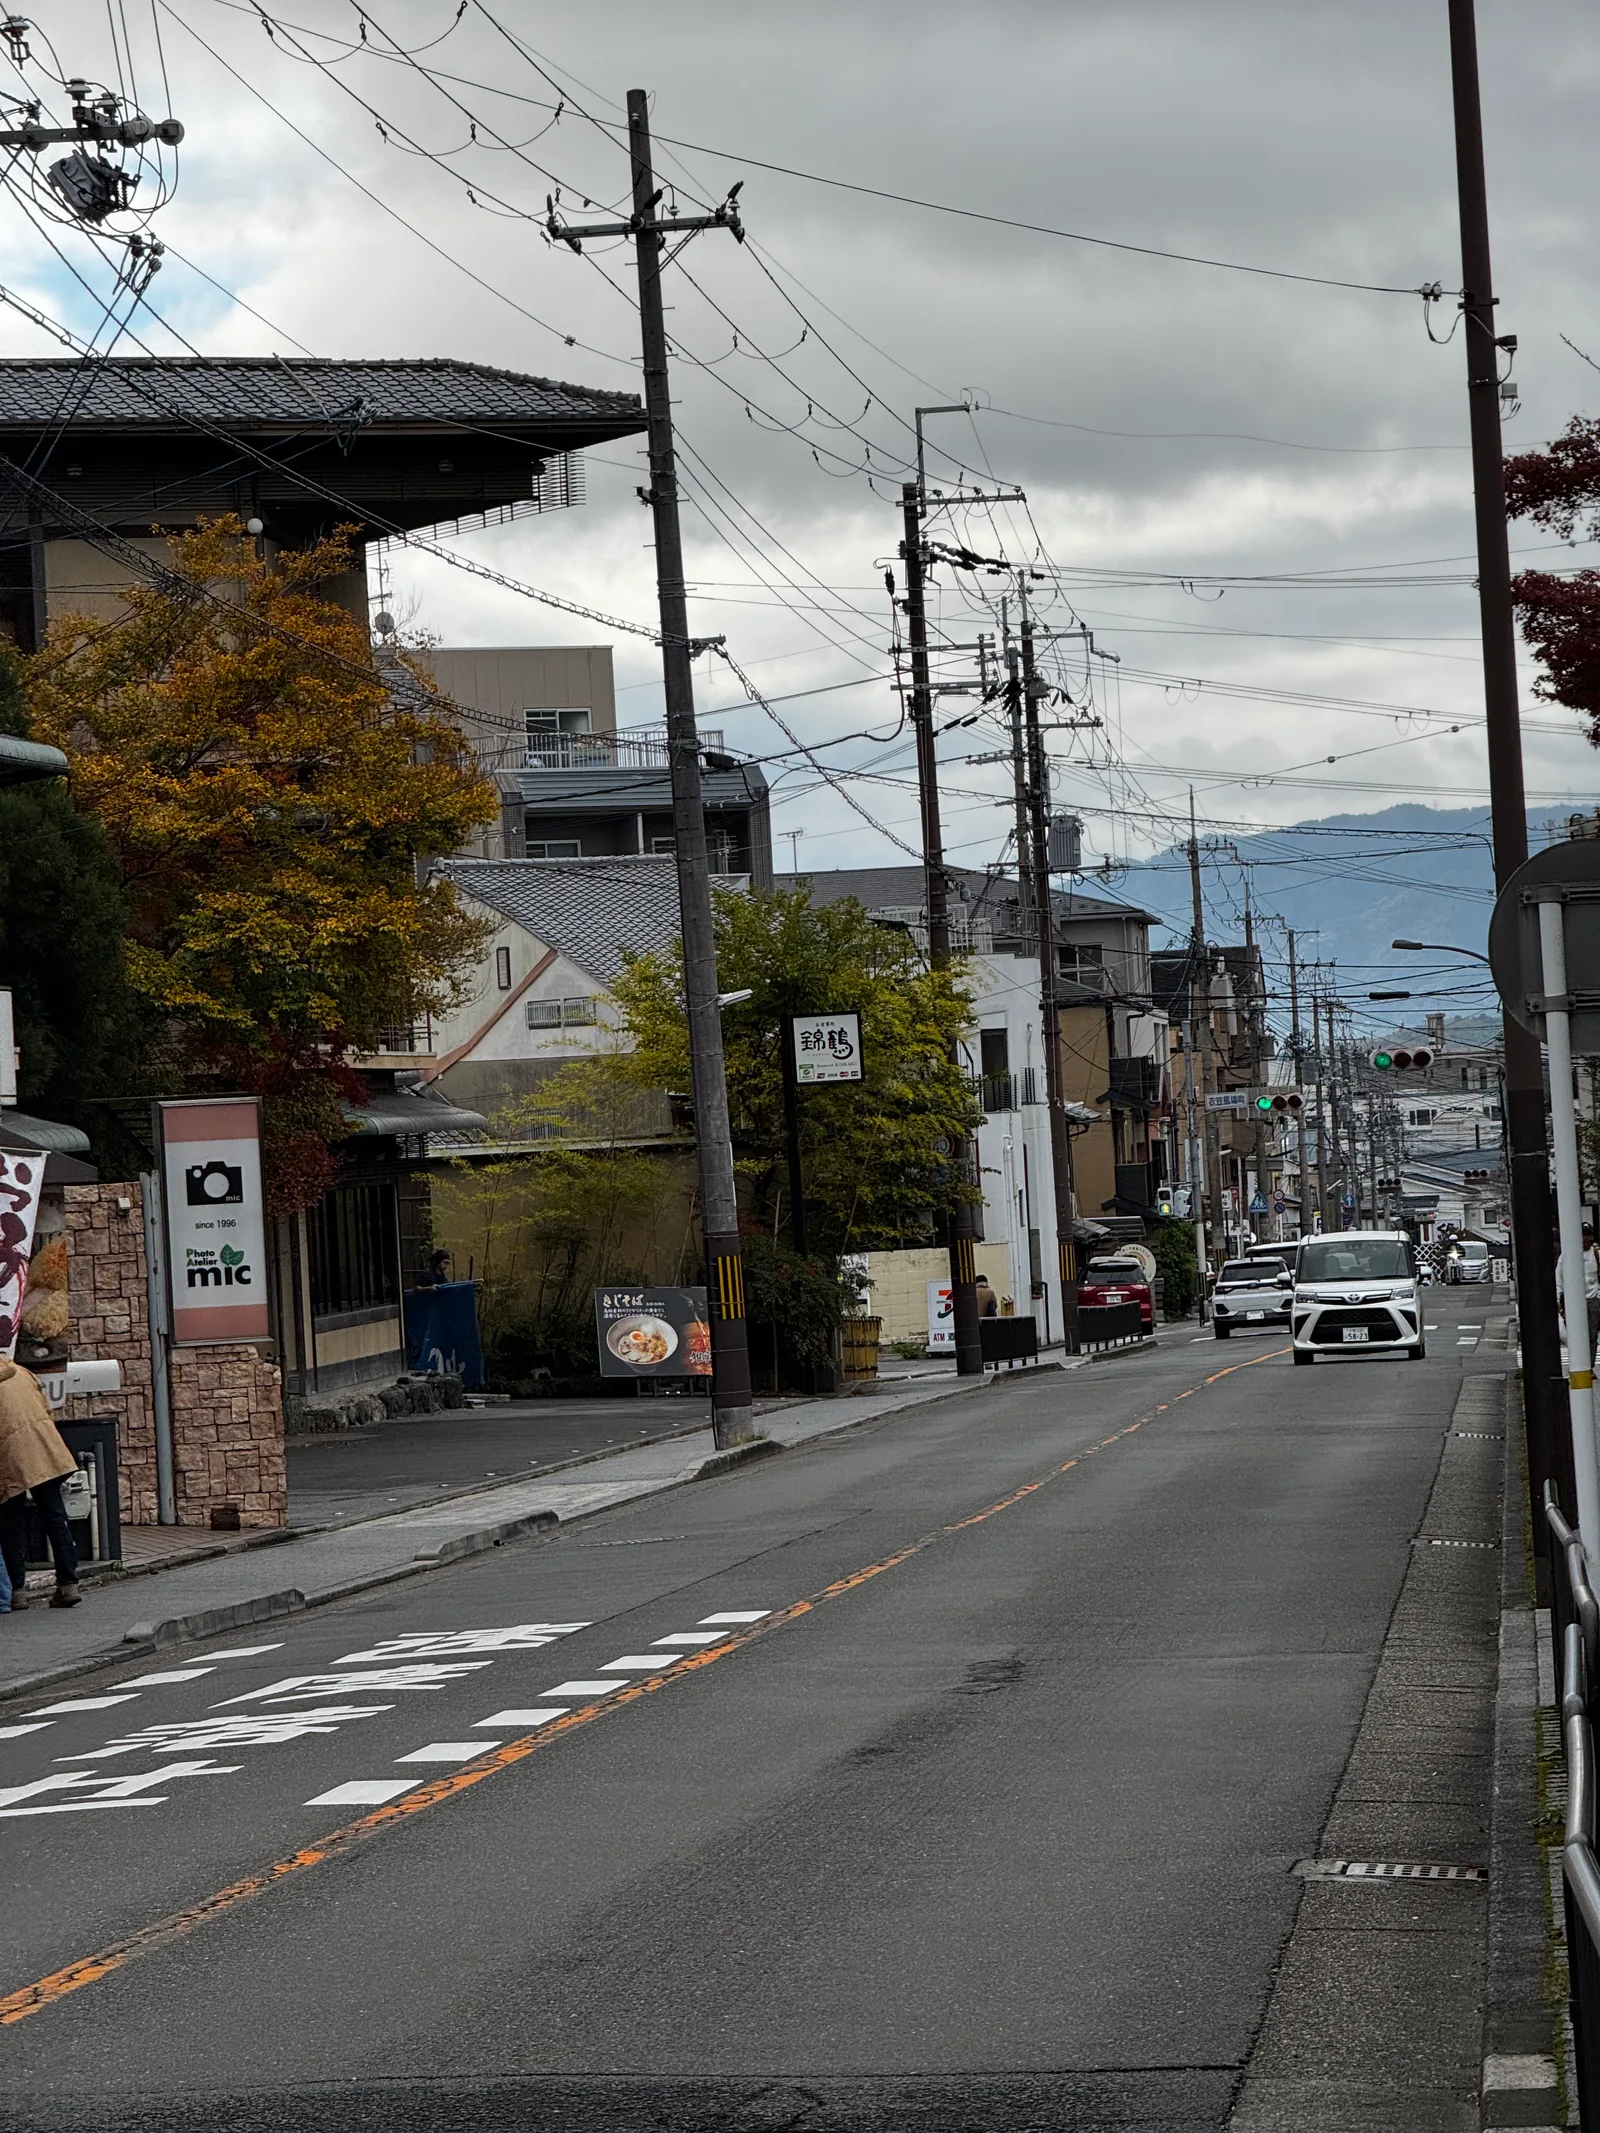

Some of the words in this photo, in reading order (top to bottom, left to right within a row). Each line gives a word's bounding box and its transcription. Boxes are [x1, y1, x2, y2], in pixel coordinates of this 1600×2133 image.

[800, 1027, 853, 1060] 錦鶴
[195, 1220, 214, 1229] since
[216, 1219, 236, 1228] 1996
[186, 1249, 215, 1258] Photo
[187, 1257, 218, 1267] Atelier
[187, 1265, 251, 1287] mic
[603, 1294, 644, 1307] きじそば
[933, 1333, 945, 1342] ATM
[1347, 1332, 1368, 1341] 58-23
